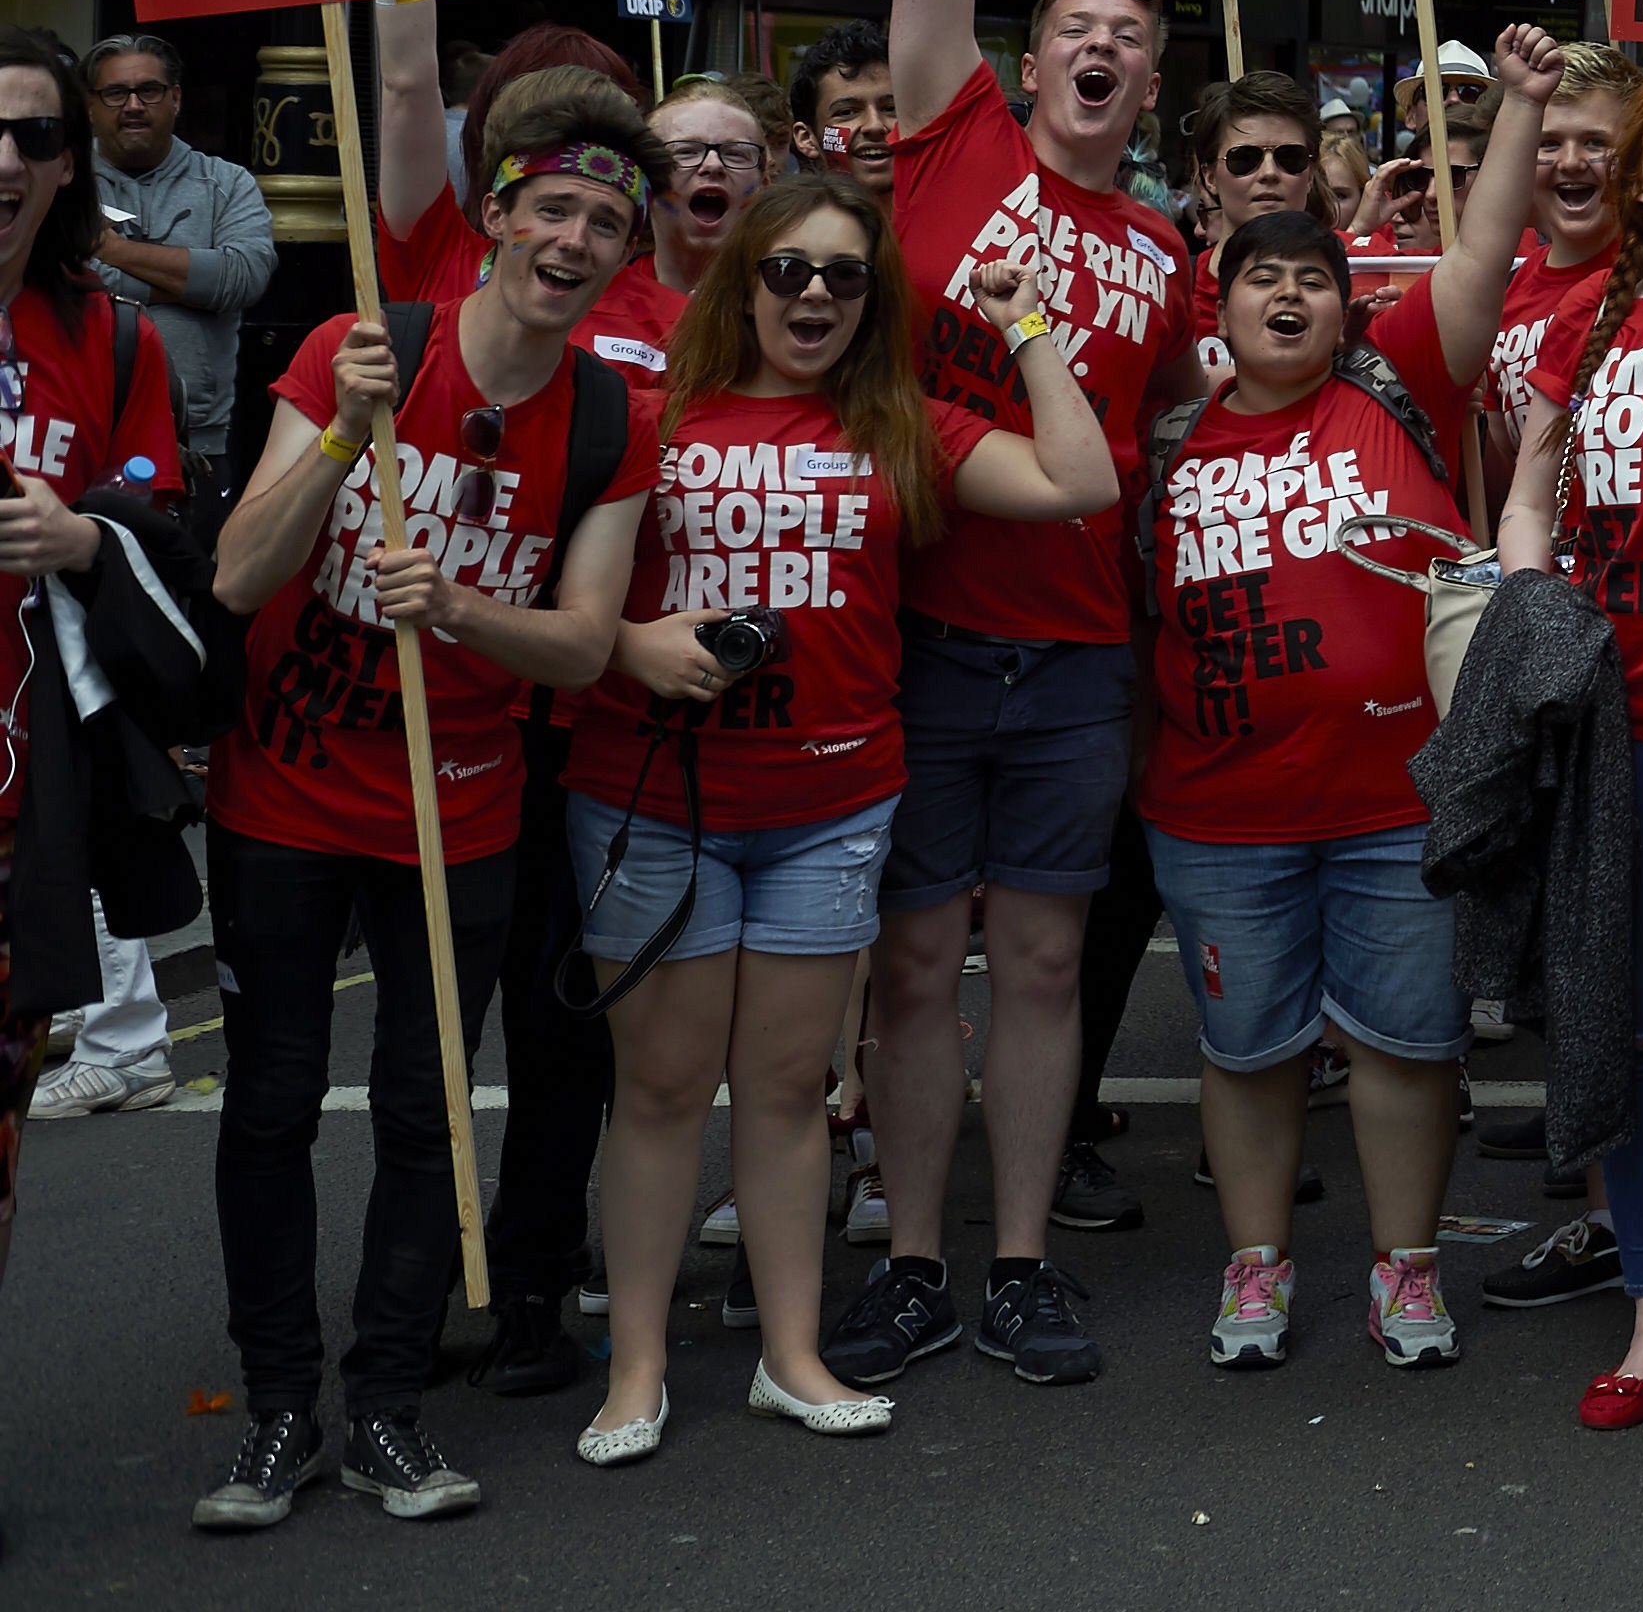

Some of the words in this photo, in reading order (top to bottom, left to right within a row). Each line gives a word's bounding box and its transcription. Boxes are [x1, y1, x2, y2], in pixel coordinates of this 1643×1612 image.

[1095, 280, 1151, 344] YN
[611, 342, 647, 360] Group
[806, 458, 848, 472] Group
[1169, 430, 1310, 488] SOME
[658, 490, 869, 551] PEOPLE
[1169, 449, 1365, 534] PEOPLE
[661, 551, 760, 613] ARE
[769, 551, 846, 610] BI.
[1175, 518, 1273, 586] ARE
[1177, 572, 1269, 637] GET
[1192, 619, 1327, 685] OVER
[1376, 696, 1423, 717] Stonewall
